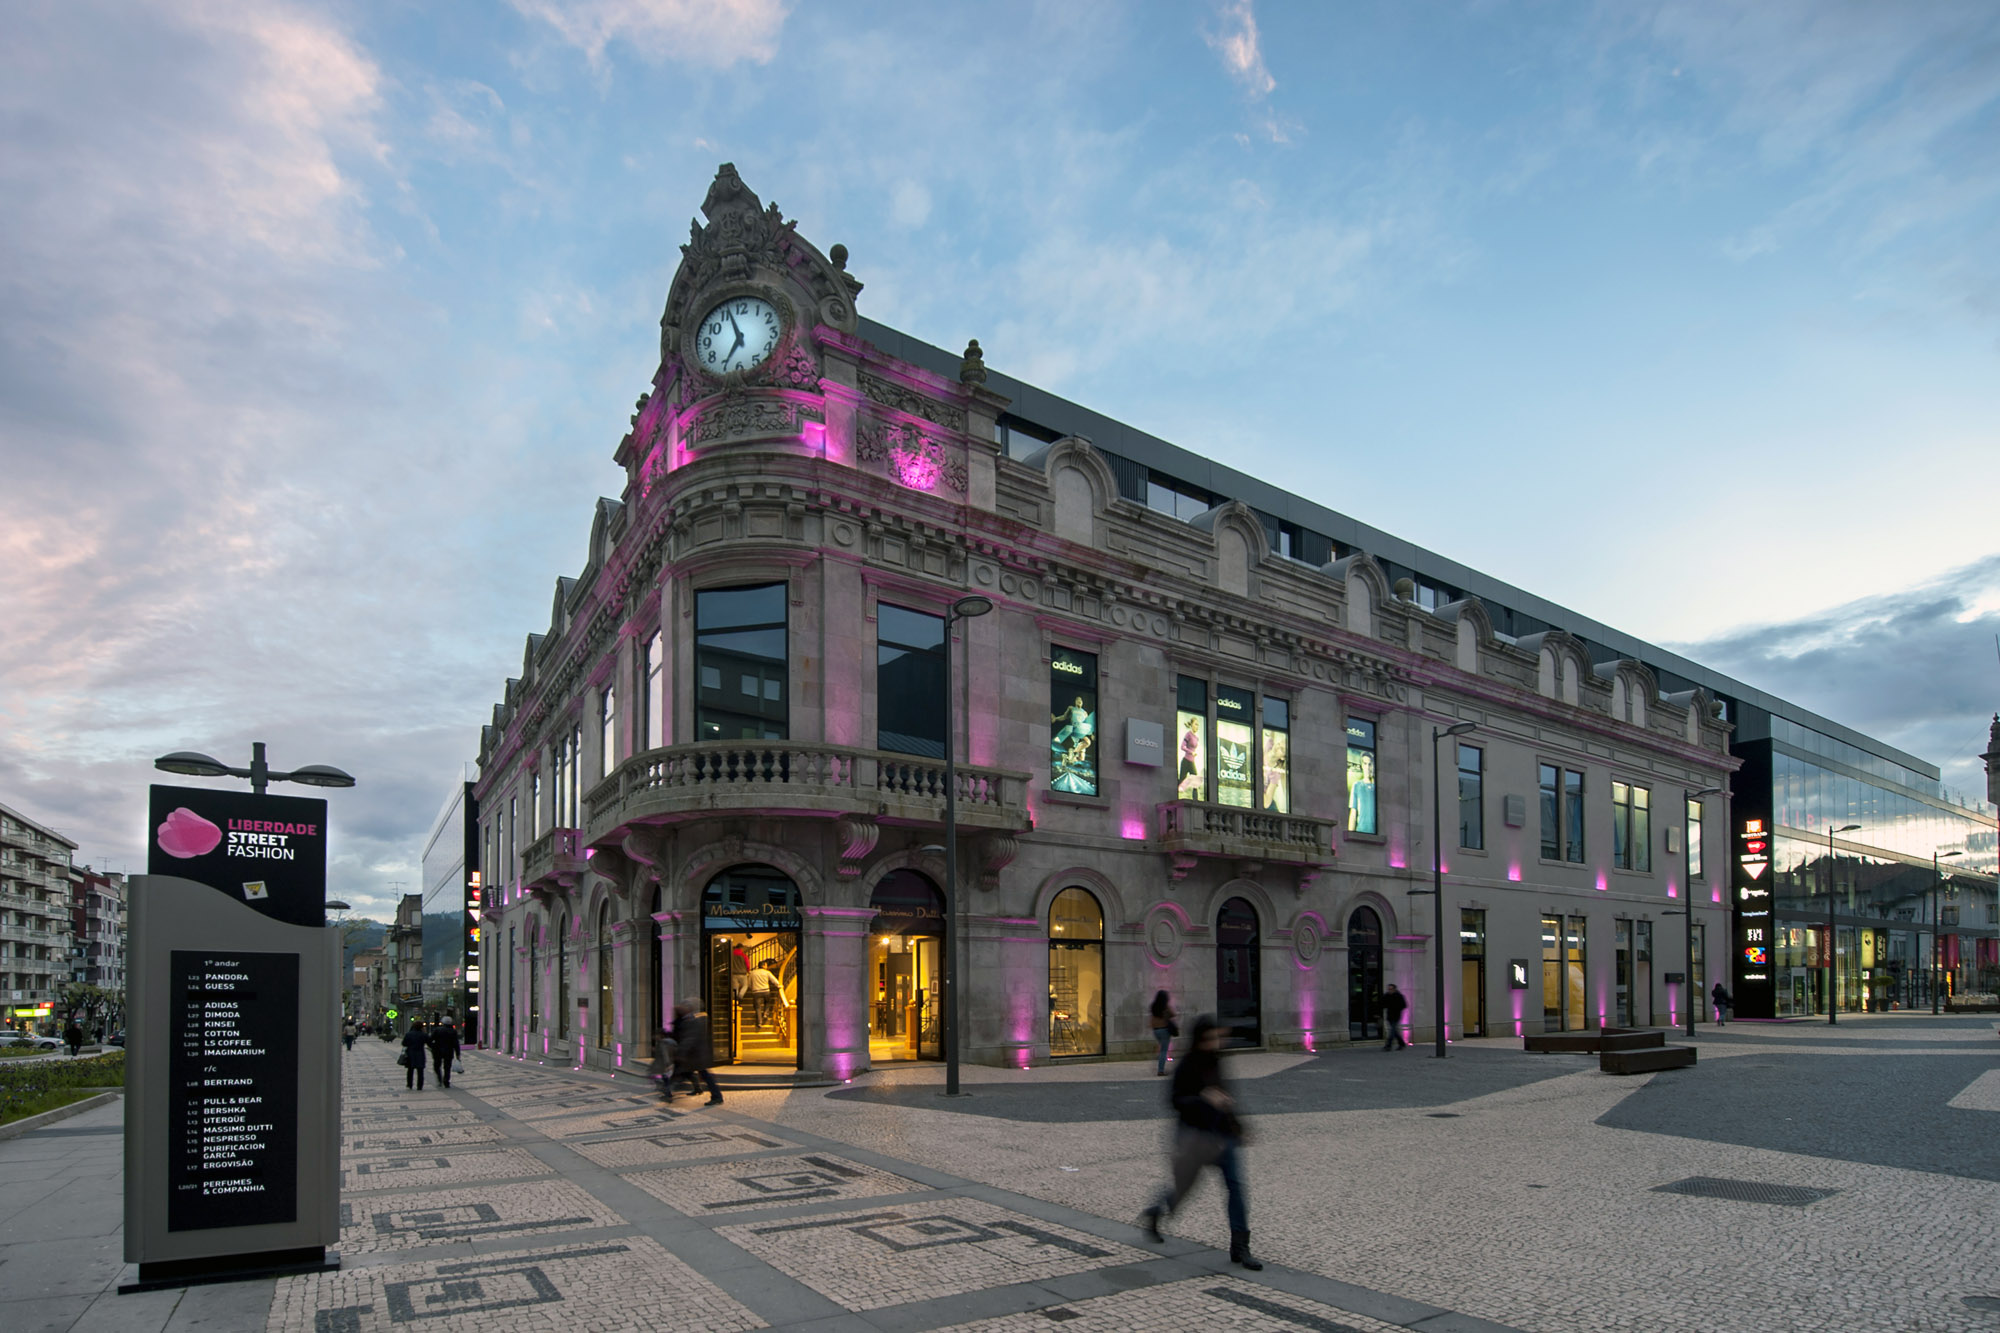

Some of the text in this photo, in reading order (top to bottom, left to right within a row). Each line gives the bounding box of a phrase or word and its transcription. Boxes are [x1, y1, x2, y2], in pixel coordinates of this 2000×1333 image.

[736, 302, 748, 315] 12
[755, 305, 760, 316] 1
[721, 310, 730, 322] 11
[765, 312, 773, 324] 2
[709, 322, 722, 335] 10
[769, 326, 778, 339] 3
[703, 337, 712, 350] 9
[763, 341, 772, 352] 4
[708, 351, 716, 363] 8
[752, 354, 761, 367] 5
[1052, 661, 1083, 675] adidas
[1217, 698, 1242, 710] adidas
[1347, 727, 1366, 738] adidas
[1134, 738, 1159, 748] adidas
[1220, 769, 1247, 781] adidas
[228, 818, 317, 836] LIBERDADE
[228, 832, 288, 846] STREET
[227, 844, 295, 860] FASHION
[710, 903, 791, 917] Massimo Dutti
[205, 973, 249, 981] PANDORA
[204, 1048, 266, 1056] IMAGINARIUM
[204, 1078, 253, 1086] BERTRAND
[238, 1096, 263, 1104] BEAR
[203, 1106, 247, 1115] BERSHKA
[203, 1115, 246, 1124] UTERQÜE
[203, 1125, 245, 1134] MASSIMO
[247, 1123, 273, 1132] DUTTI
[203, 1134, 257, 1143] NESPRESSO
[203, 1143, 265, 1152] PURIFICACION
[203, 1151, 236, 1160] GARCIA
[203, 1159, 254, 1169] ERGOVISÃO
[203, 1178, 252, 1188] PERFUMES
[212, 1184, 265, 1195] COMPANHIA
